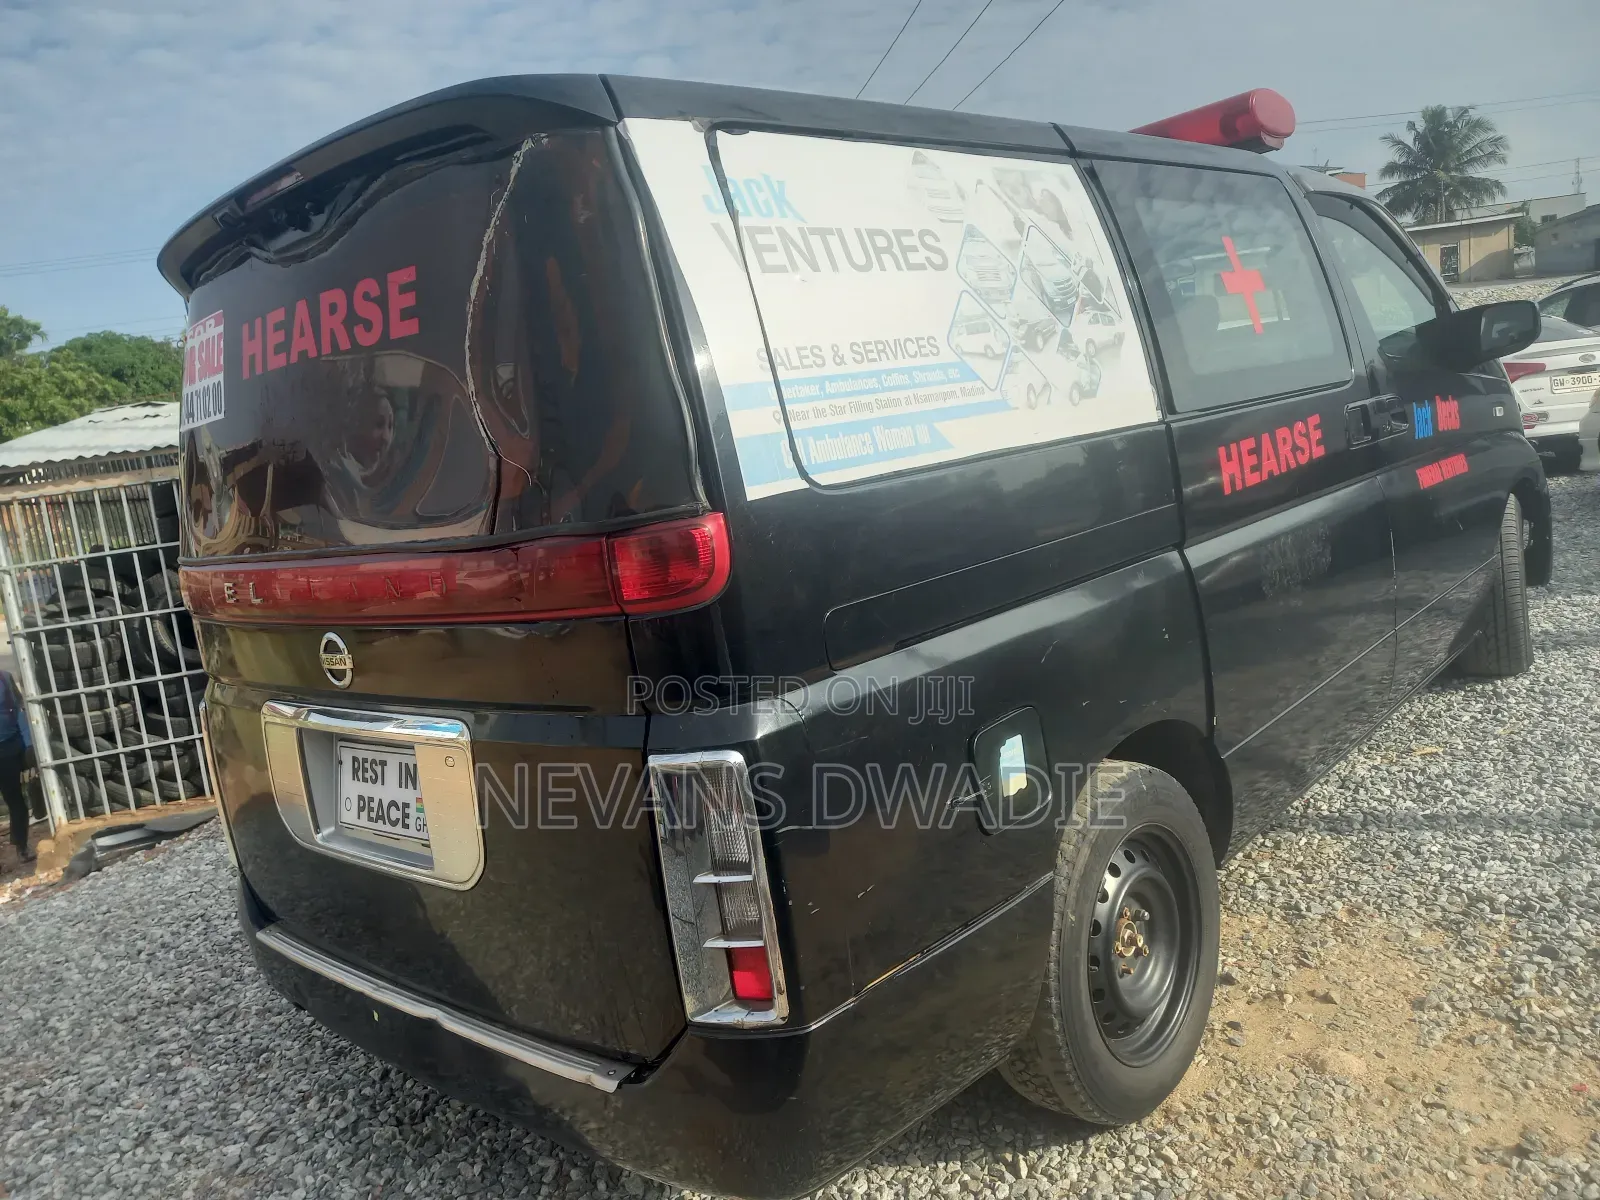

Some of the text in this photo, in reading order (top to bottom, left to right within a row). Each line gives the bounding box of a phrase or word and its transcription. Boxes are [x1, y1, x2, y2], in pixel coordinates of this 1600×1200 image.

[710, 222, 949, 274] VENTURES
[242, 265, 419, 380] HEARSE
[198, 332, 224, 382] SALE
[756, 335, 940, 372] SALES & SERVICES
[826, 377, 881, 394] Ambulances,
[789, 407, 809, 423] Near
[814, 406, 828, 420] the
[830, 403, 846, 418] Star
[849, 399, 874, 415] Filling
[875, 395, 903, 411] Station
[904, 393, 913, 406] at
[809, 430, 874, 466] Ambulance
[1218, 413, 1326, 496] HEARSE
[352, 756, 417, 790] REST IN
[357, 795, 410, 829] PEACE
